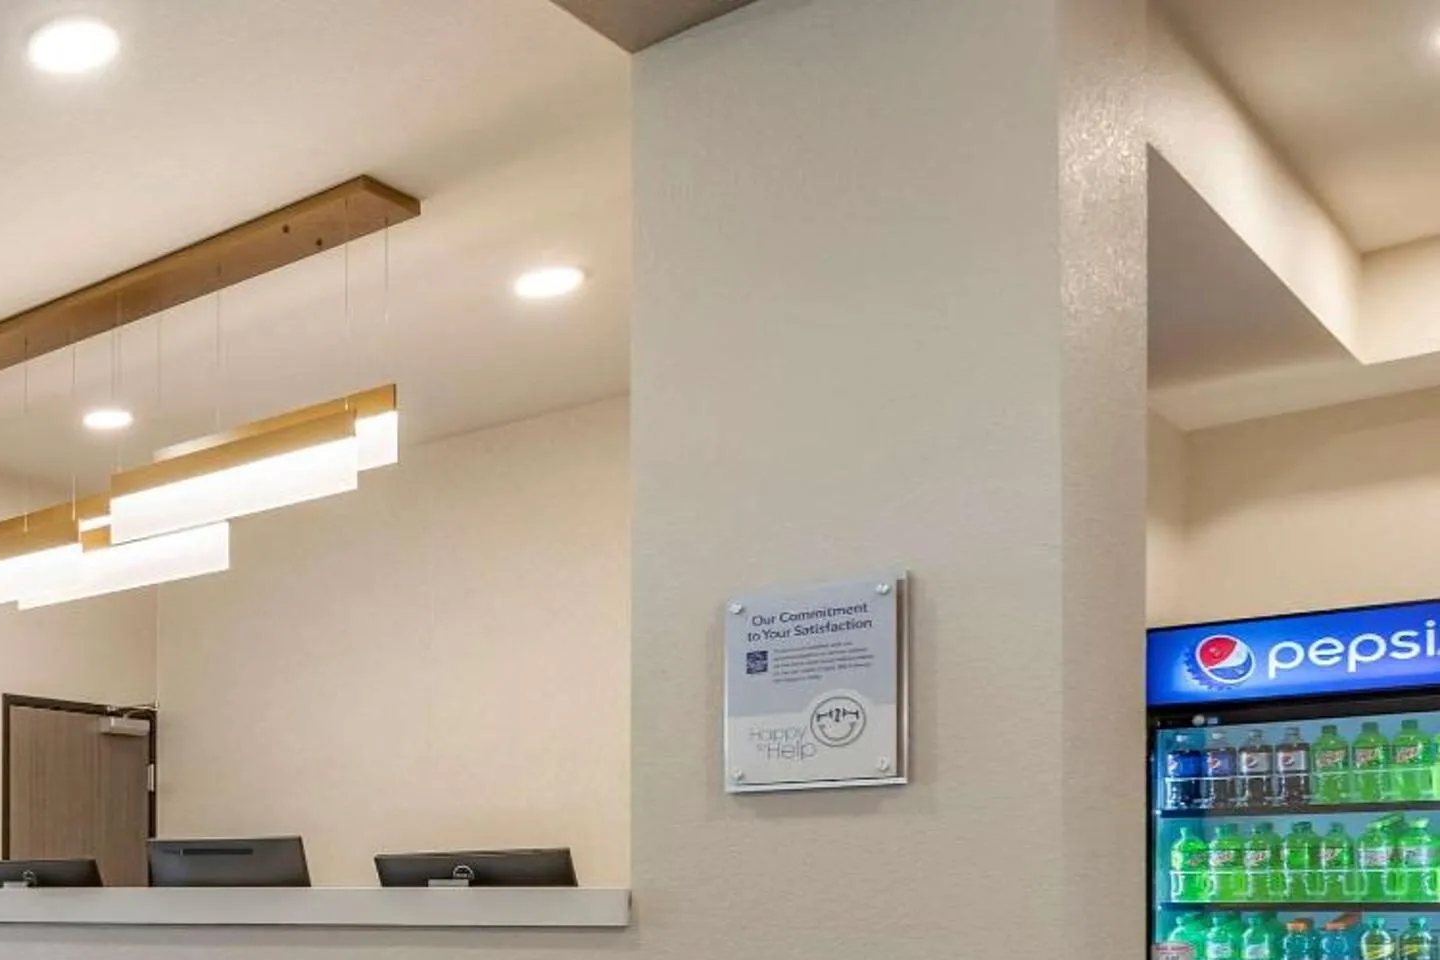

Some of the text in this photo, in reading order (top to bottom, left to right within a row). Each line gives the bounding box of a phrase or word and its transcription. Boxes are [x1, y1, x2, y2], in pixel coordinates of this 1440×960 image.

[751, 603, 869, 627] Our Commitment
[747, 618, 873, 642] to Your Satisfaction
[1268, 619, 1436, 680] pepsi
[749, 725, 808, 744] Happy
[767, 740, 817, 761] Help
